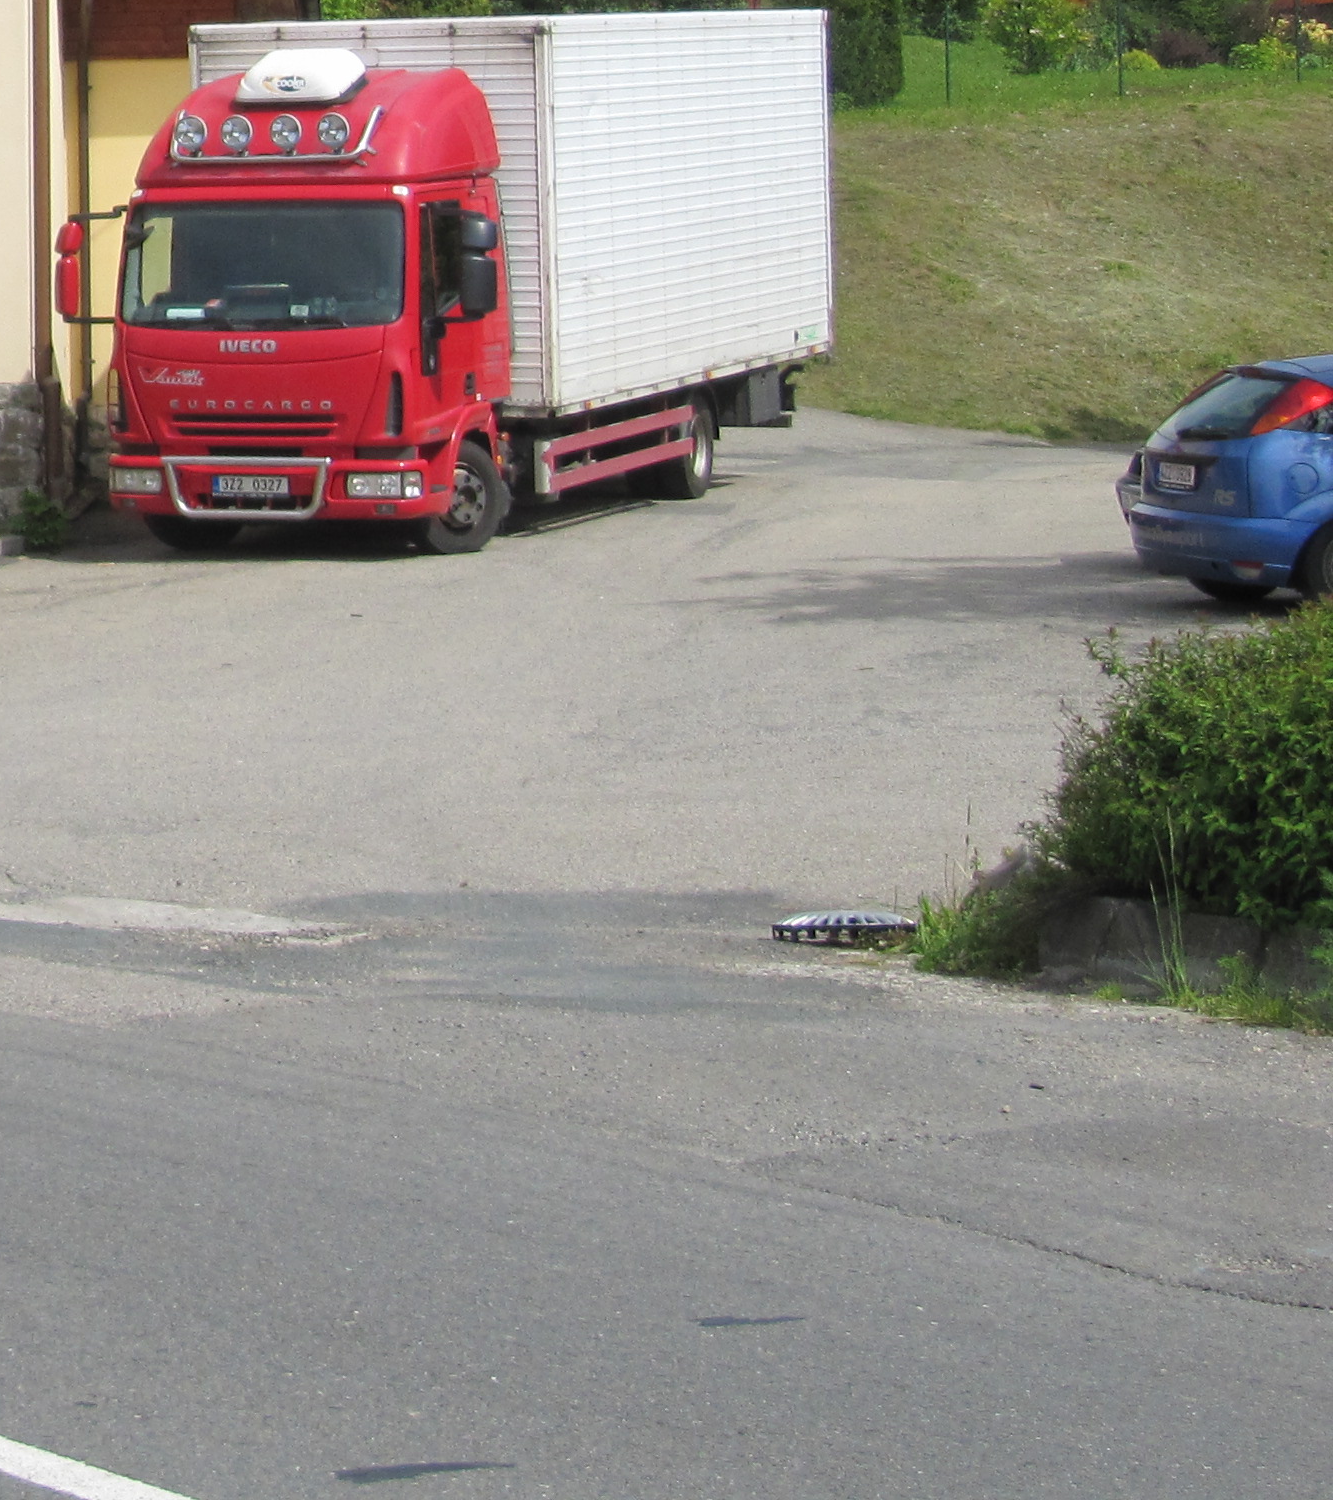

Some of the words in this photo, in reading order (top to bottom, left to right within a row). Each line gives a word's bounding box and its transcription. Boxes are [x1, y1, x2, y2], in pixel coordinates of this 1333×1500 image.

[219, 339, 277, 353] IVECO
[169, 399, 333, 410] EUROCARGO
[221, 477, 244, 491] 3Z2
[252, 477, 283, 492] 0327
